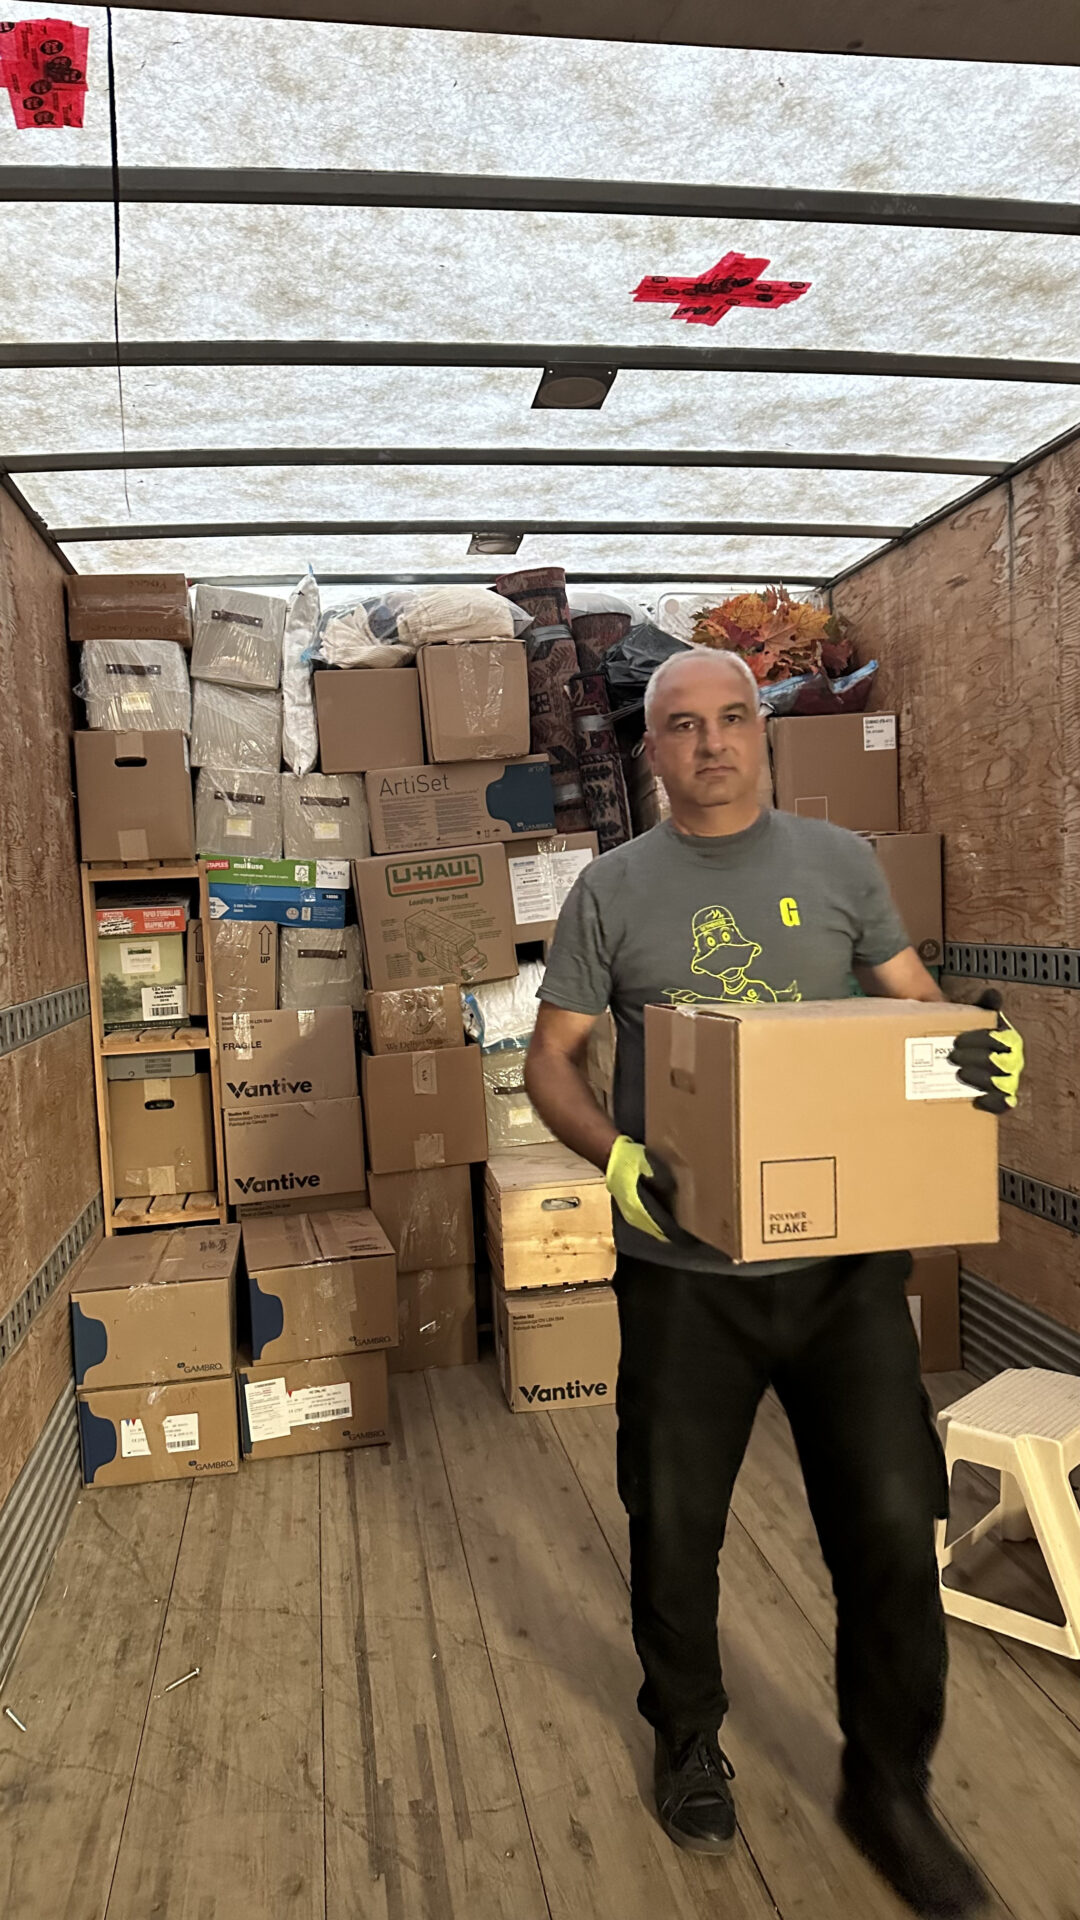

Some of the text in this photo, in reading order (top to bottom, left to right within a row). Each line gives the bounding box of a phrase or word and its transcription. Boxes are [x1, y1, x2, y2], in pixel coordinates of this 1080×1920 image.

[379, 774, 450, 797] ArtiSet
[392, 861, 477, 883] U-HAUL
[780, 897, 800, 927] G
[260, 956, 271, 964] UP
[226, 1077, 312, 1099] Vantive
[234, 1172, 320, 1194] Vantive
[769, 1211, 807, 1221] POLYMER
[770, 1221, 808, 1235] FLAKE
[184, 1362, 223, 1374] GAMBRO
[519, 1380, 607, 1404] Vantive
[195, 1460, 232, 1472] GAMBRO
